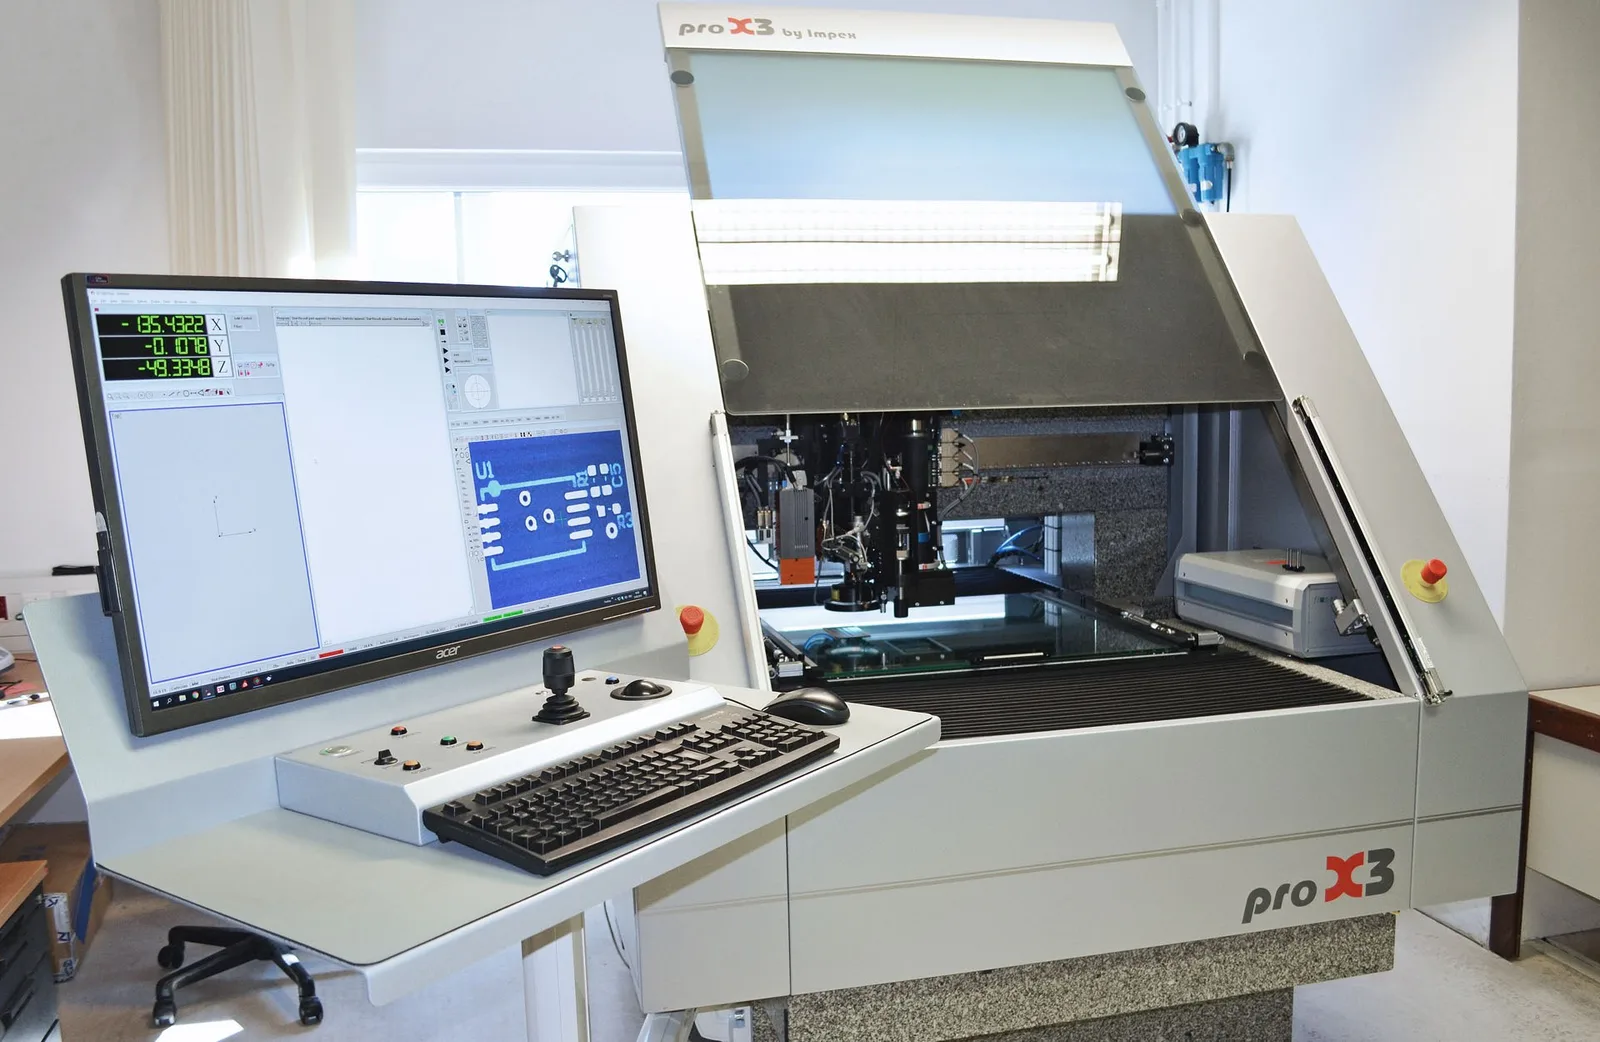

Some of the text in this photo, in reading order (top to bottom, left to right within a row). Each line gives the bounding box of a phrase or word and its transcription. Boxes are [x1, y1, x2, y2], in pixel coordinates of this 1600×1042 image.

[782, 28, 802, 40] by
[808, 29, 857, 40] Impex
[212, 318, 222, 331] X
[213, 339, 224, 352] Y
[217, 360, 228, 374] Z
[475, 460, 495, 480] U1
[609, 463, 623, 488] C5
[616, 511, 634, 530] R3
[435, 645, 461, 660] acer
